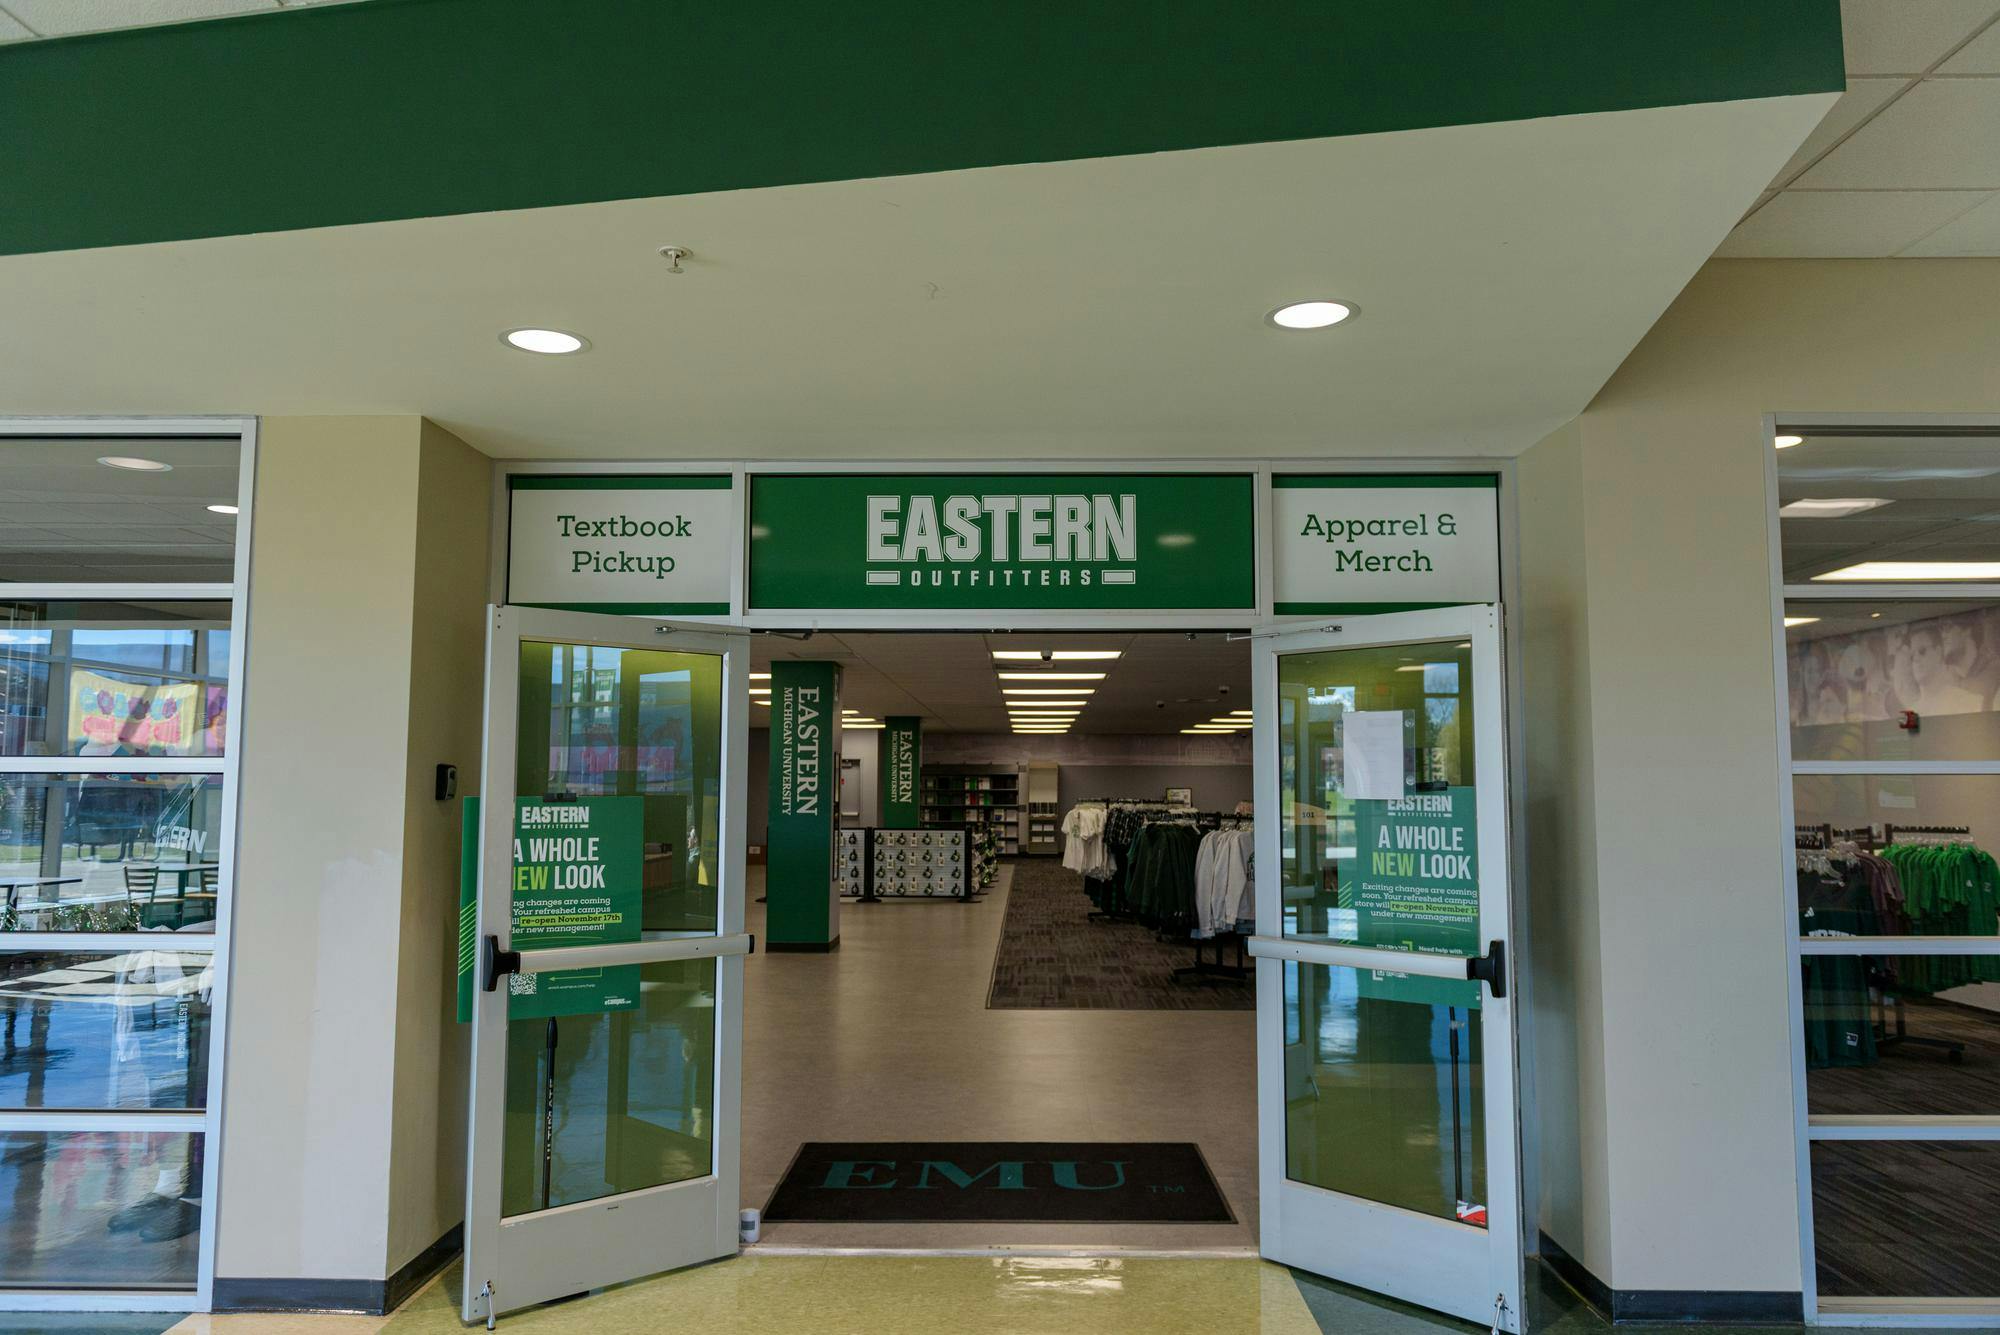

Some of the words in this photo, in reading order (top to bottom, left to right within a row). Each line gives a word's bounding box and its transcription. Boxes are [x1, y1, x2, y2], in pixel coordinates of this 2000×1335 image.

[557, 515, 692, 537] Textbook
[866, 494, 1137, 562] EASTERN
[1300, 514, 1428, 542] Apparel
[1437, 514, 1457, 536] &
[571, 551, 675, 579] Pickup
[1335, 550, 1433, 572] Merch
[911, 569, 1091, 586] OUTFITTERS
[783, 687, 793, 745] MICHIGAN
[796, 686, 819, 816] EASTERN
[899, 730, 913, 804] EASTERN
[782, 748, 792, 815] UNIVERSITY
[1387, 795, 1453, 812] EASTERN
[521, 806, 589, 824] EASTERN
[1378, 825, 1391, 849] A
[1395, 825, 1464, 852] WHOLE
[513, 838, 524, 863] A
[529, 837, 600, 862] WHOLE
[1372, 851, 1415, 877] NEW
[1420, 853, 1472, 880] LOOK
[513, 866, 549, 890] EW
[554, 864, 606, 890] LOOK
[1362, 883, 1394, 893] Exciting
[1395, 885, 1429, 894] changes
[1446, 888, 1478, 897] coming
[1403, 895, 1443, 903] refreshed
[1444, 898, 1478, 906] campus
[513, 908, 533, 916] Your
[535, 907, 576, 915] refreshed
[578, 906, 611, 915] campus
[526, 899, 562, 908] changes
[580, 897, 611, 906] coming
[1392, 903, 1424, 911] re-open
[1425, 904, 1469, 913] November
[522, 918, 556, 926] re-open
[558, 914, 602, 923] November
[547, 924, 605, 934] management!
[1415, 914, 1473, 923] management!
[810, 1161, 1133, 1190] EMU
[1147, 1184, 1185, 1193] TM
